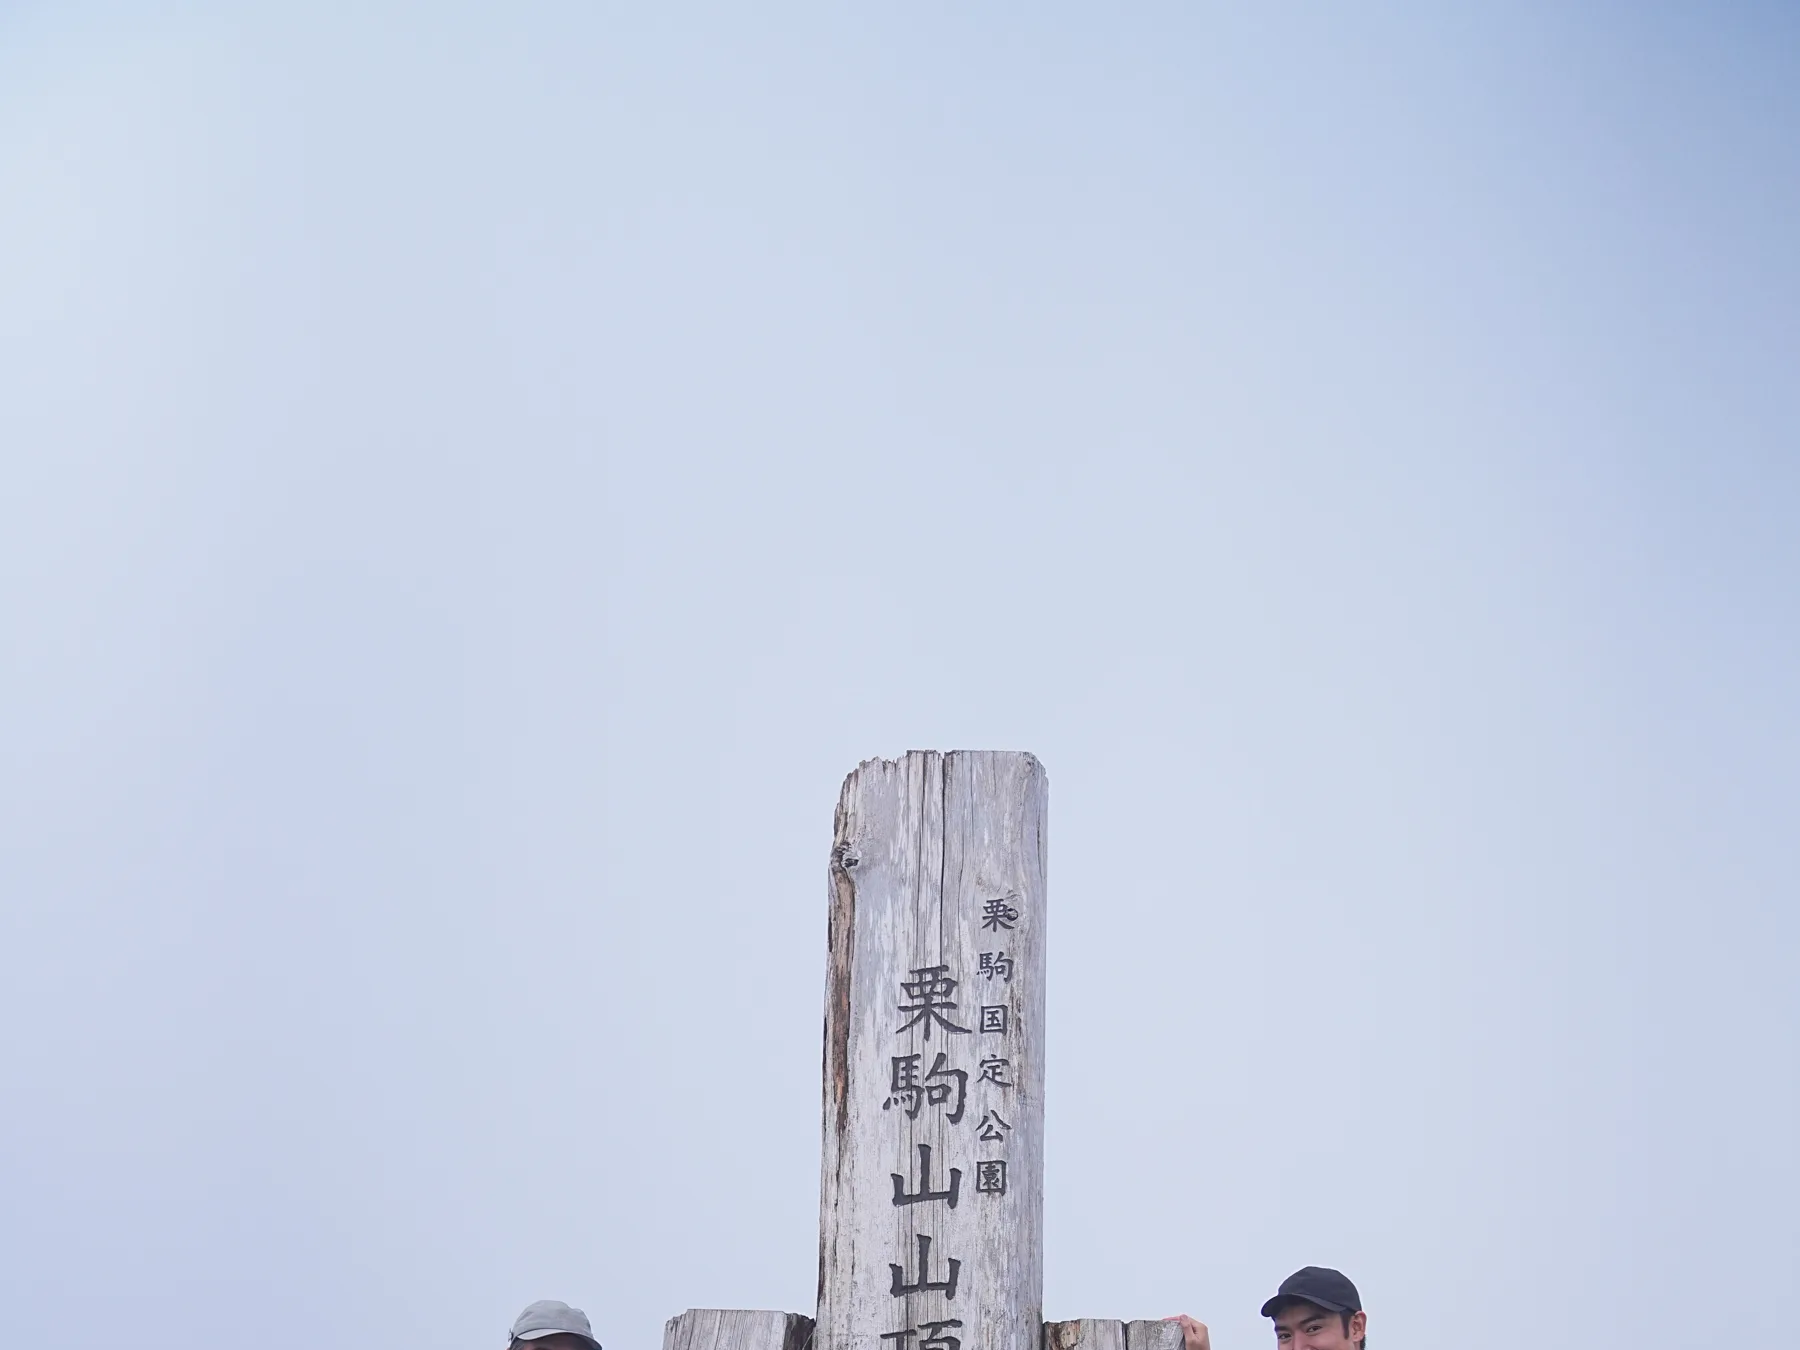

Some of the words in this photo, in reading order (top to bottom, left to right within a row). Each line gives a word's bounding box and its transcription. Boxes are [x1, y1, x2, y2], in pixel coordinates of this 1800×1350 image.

[975, 898, 1014, 1196] 栗駒国定公園
